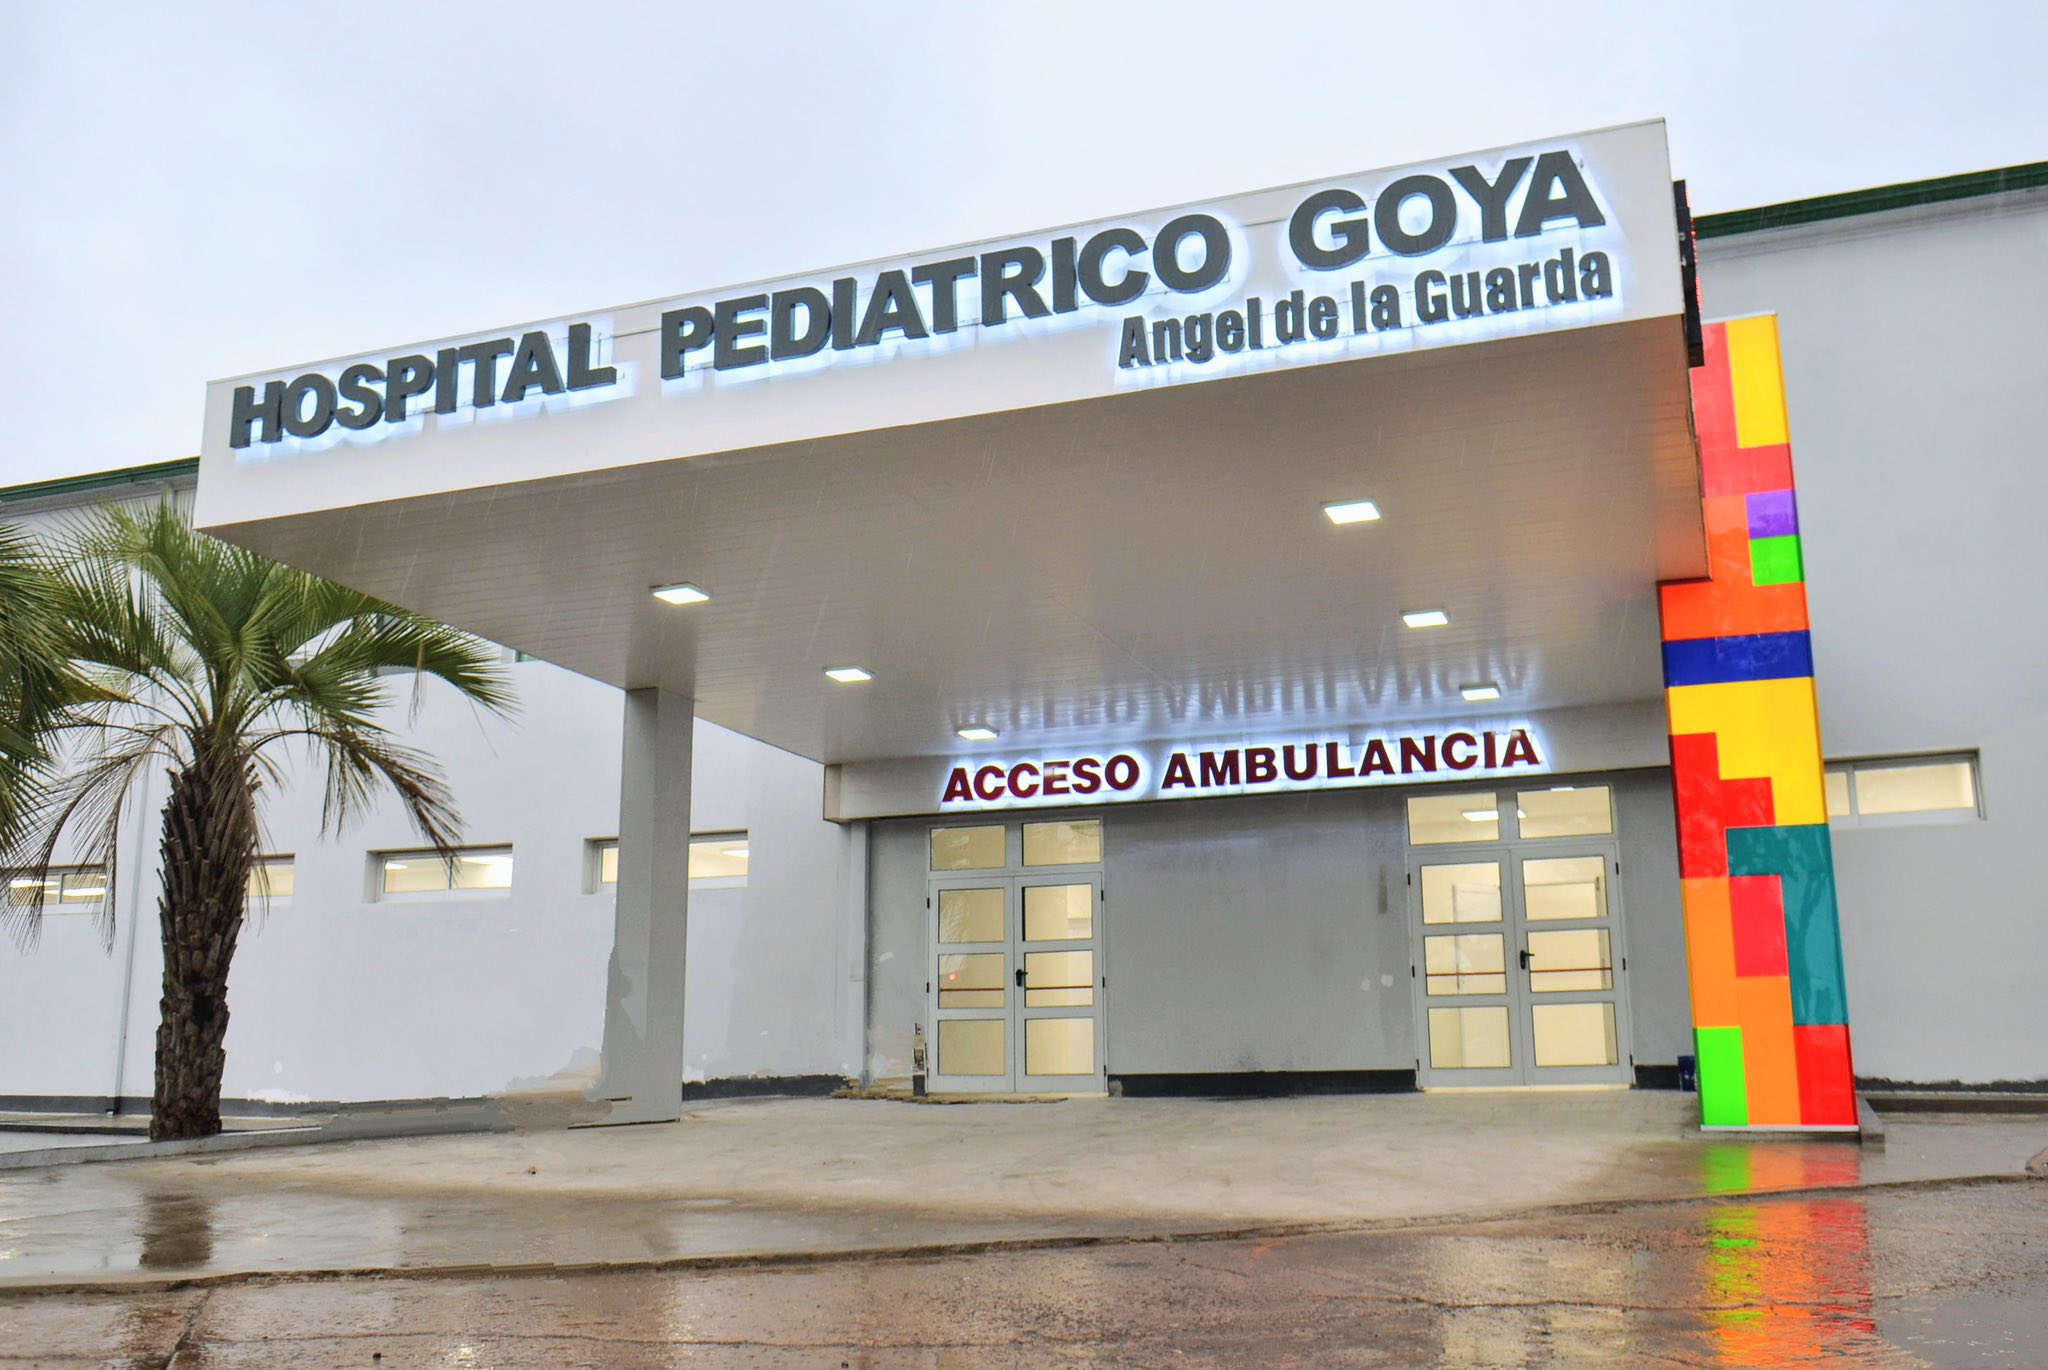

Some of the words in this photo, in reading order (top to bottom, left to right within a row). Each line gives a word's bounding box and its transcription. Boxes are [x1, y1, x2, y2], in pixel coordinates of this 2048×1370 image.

[229, 322, 617, 449] HOSPITAL
[660, 213, 1232, 381] PEDIATRICO
[1288, 149, 1606, 272] GOYA
[1118, 296, 1264, 369] Angel
[1274, 289, 1339, 344] de
[1351, 280, 1401, 335] la
[1414, 247, 1613, 324] Guarda
[941, 754, 1140, 803] ACCESO
[1160, 728, 1540, 789] AMBULANCIA
